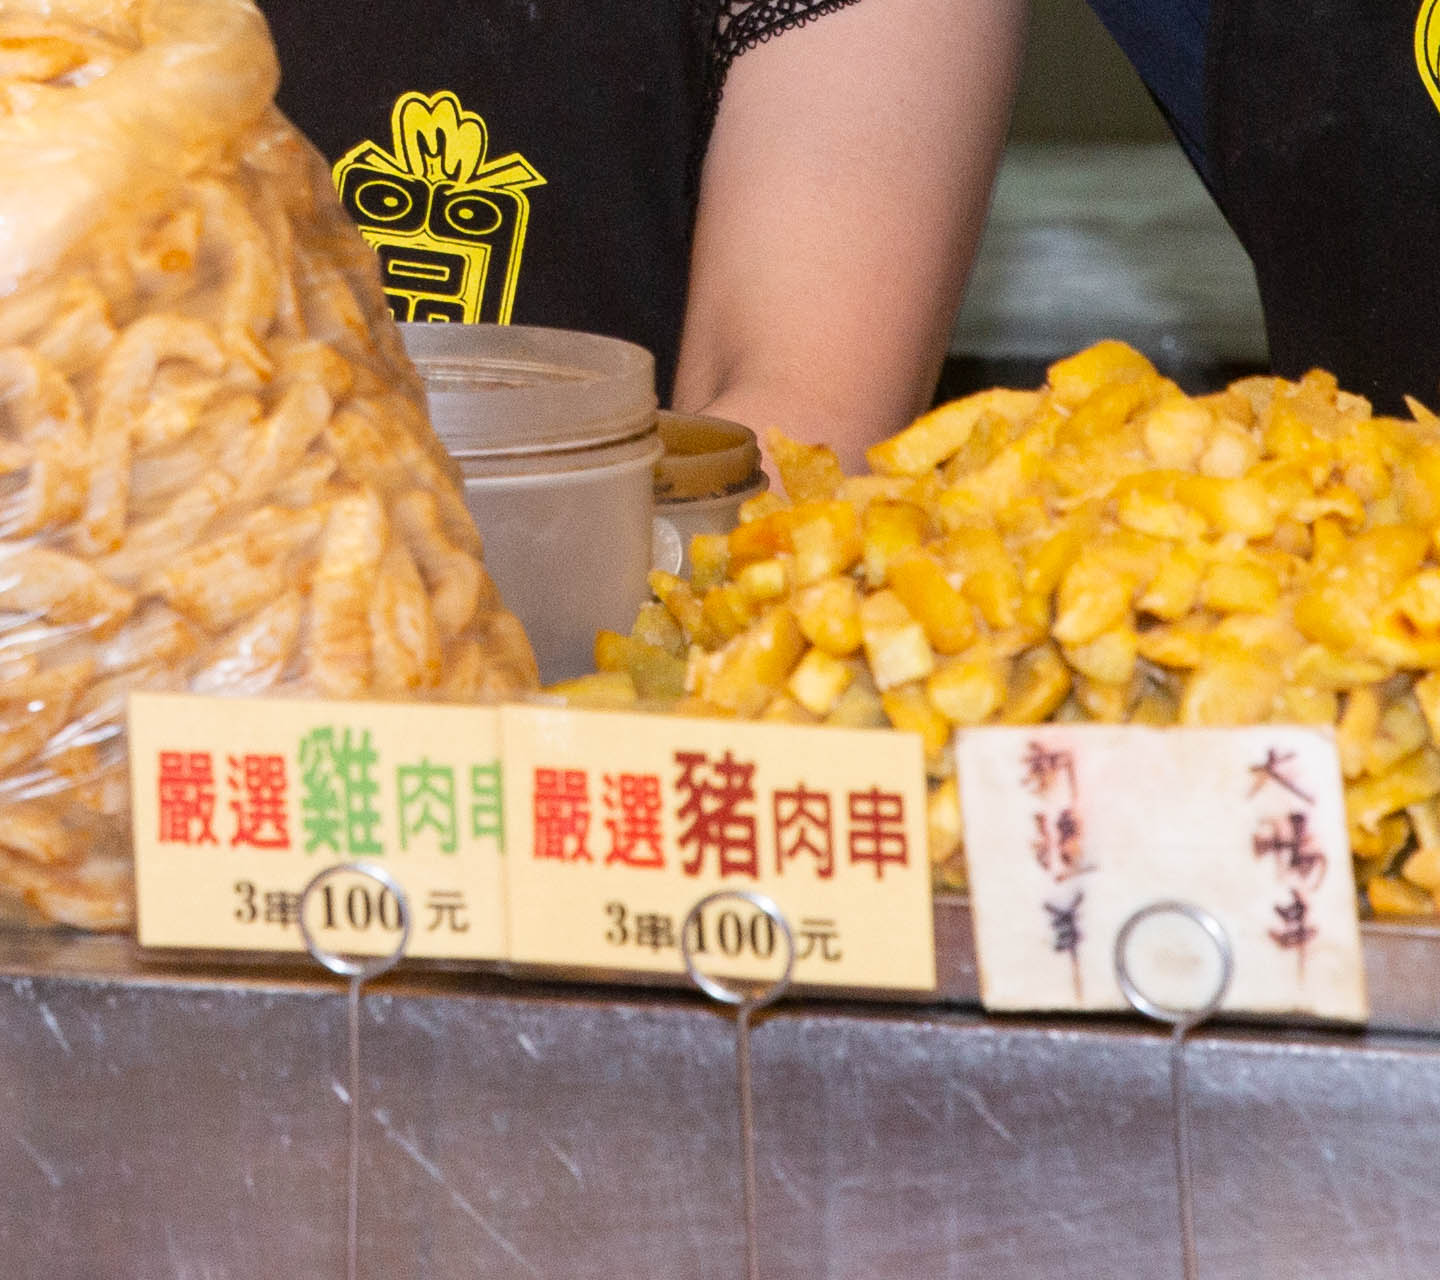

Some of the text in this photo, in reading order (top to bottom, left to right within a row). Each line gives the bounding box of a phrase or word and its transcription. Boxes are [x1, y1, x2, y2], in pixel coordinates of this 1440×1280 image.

[532, 750, 910, 881] 嚴選豬肉串
[320, 885, 406, 932] 100
[426, 890, 470, 933] 元
[689, 910, 776, 960] 100
[796, 917, 843, 963] 元
